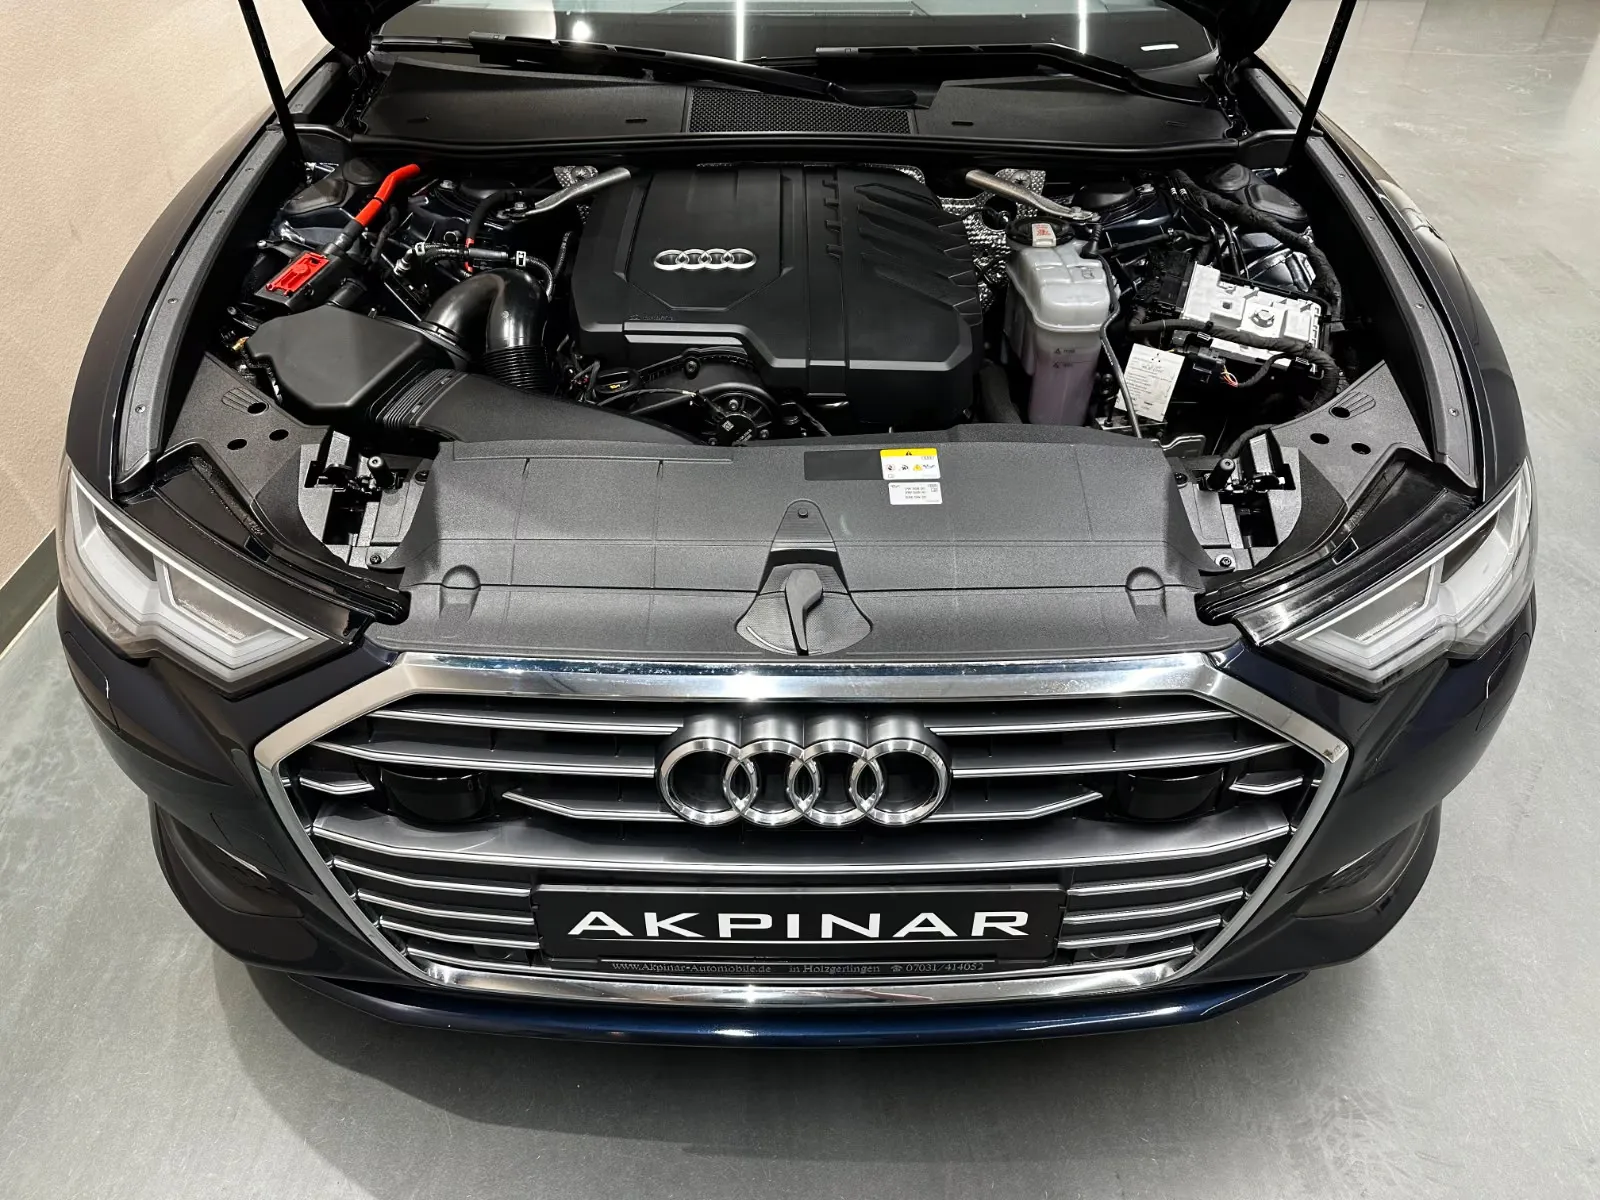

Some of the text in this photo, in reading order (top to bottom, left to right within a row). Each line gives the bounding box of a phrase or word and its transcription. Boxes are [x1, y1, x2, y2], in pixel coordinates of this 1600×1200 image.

[567, 911, 1029, 938] AKPINAR
[612, 962, 771, 974] www.Akpinar-Automobile.de
[789, 965, 800, 973] in
[803, 963, 880, 975] Holzgerlingen
